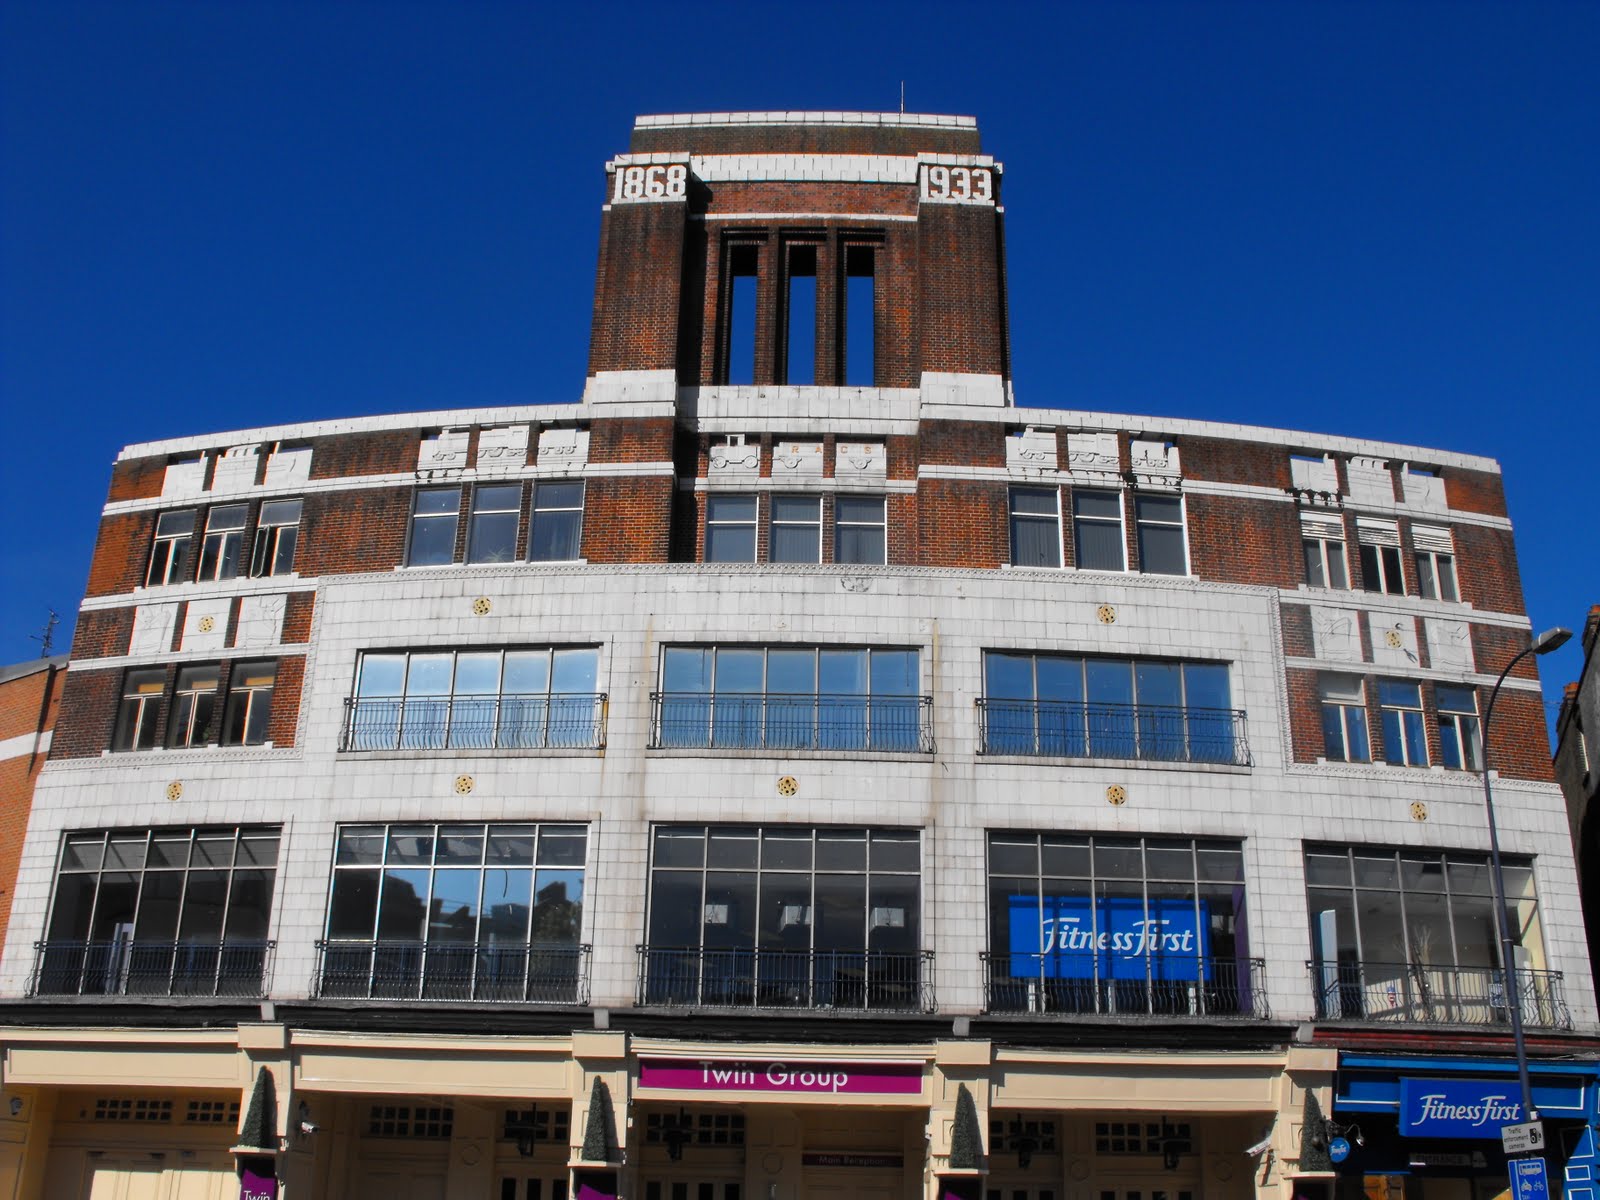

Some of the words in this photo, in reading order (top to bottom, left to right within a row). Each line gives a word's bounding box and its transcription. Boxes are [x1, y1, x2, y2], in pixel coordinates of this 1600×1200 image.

[614, 165, 687, 199] 1868
[920, 166, 993, 201] 1933
[766, 1062, 849, 1093] Group
